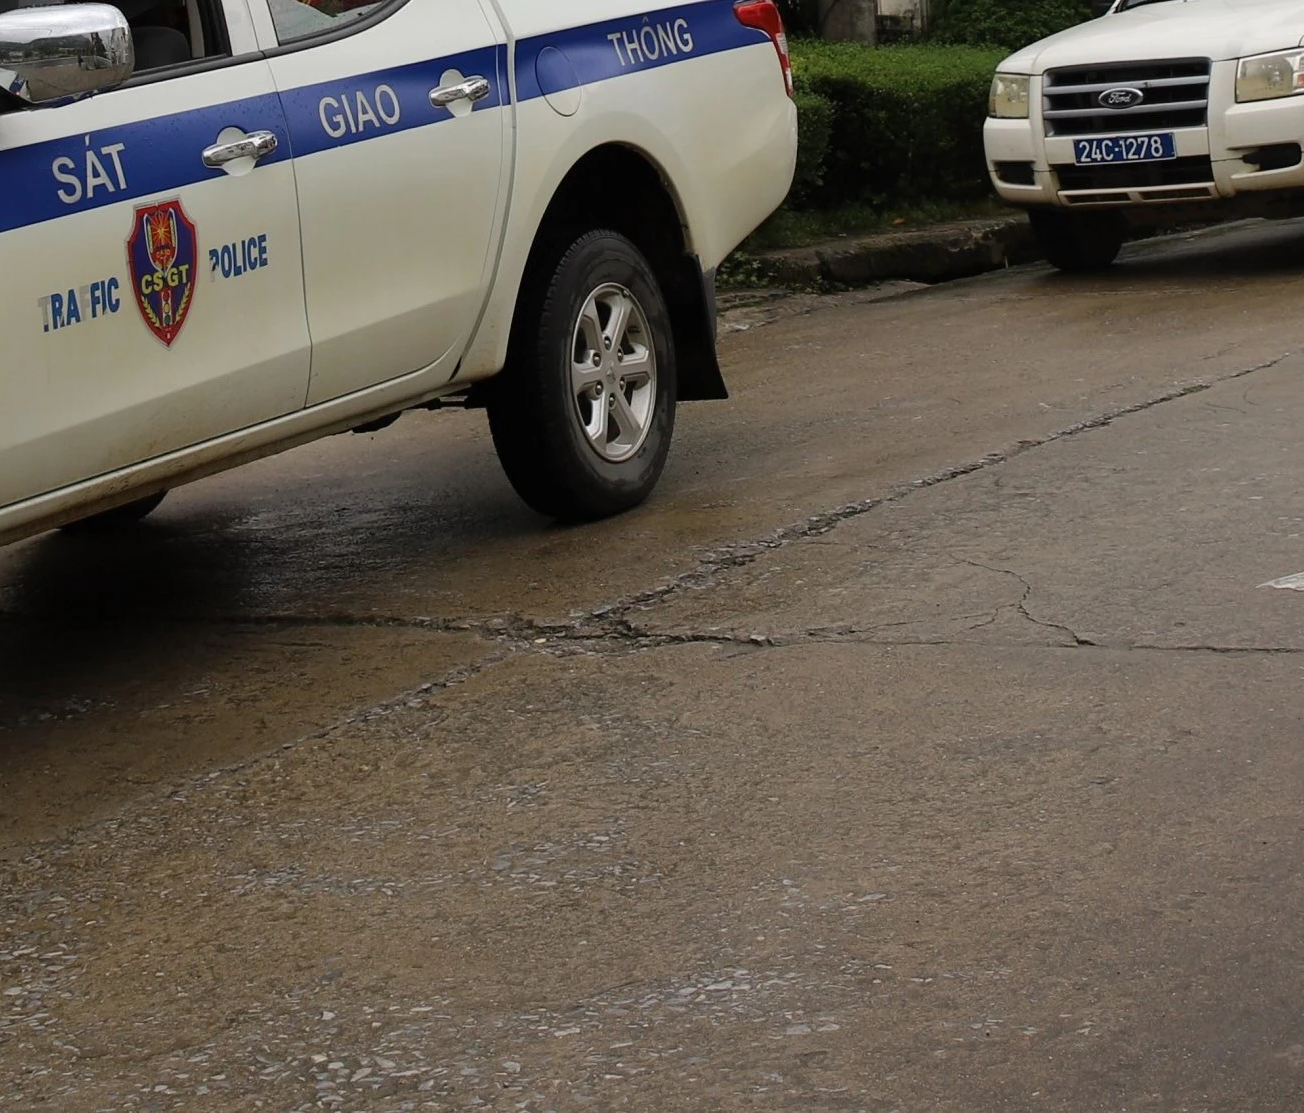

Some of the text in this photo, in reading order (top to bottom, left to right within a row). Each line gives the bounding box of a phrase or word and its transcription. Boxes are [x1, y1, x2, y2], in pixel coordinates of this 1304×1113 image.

[52, 134, 127, 204] SÁT
[318, 84, 400, 139] GIAO
[607, 17, 694, 67] THÔNG
[1108, 91, 1132, 105] Ford
[208, 234, 268, 283] POLICE
